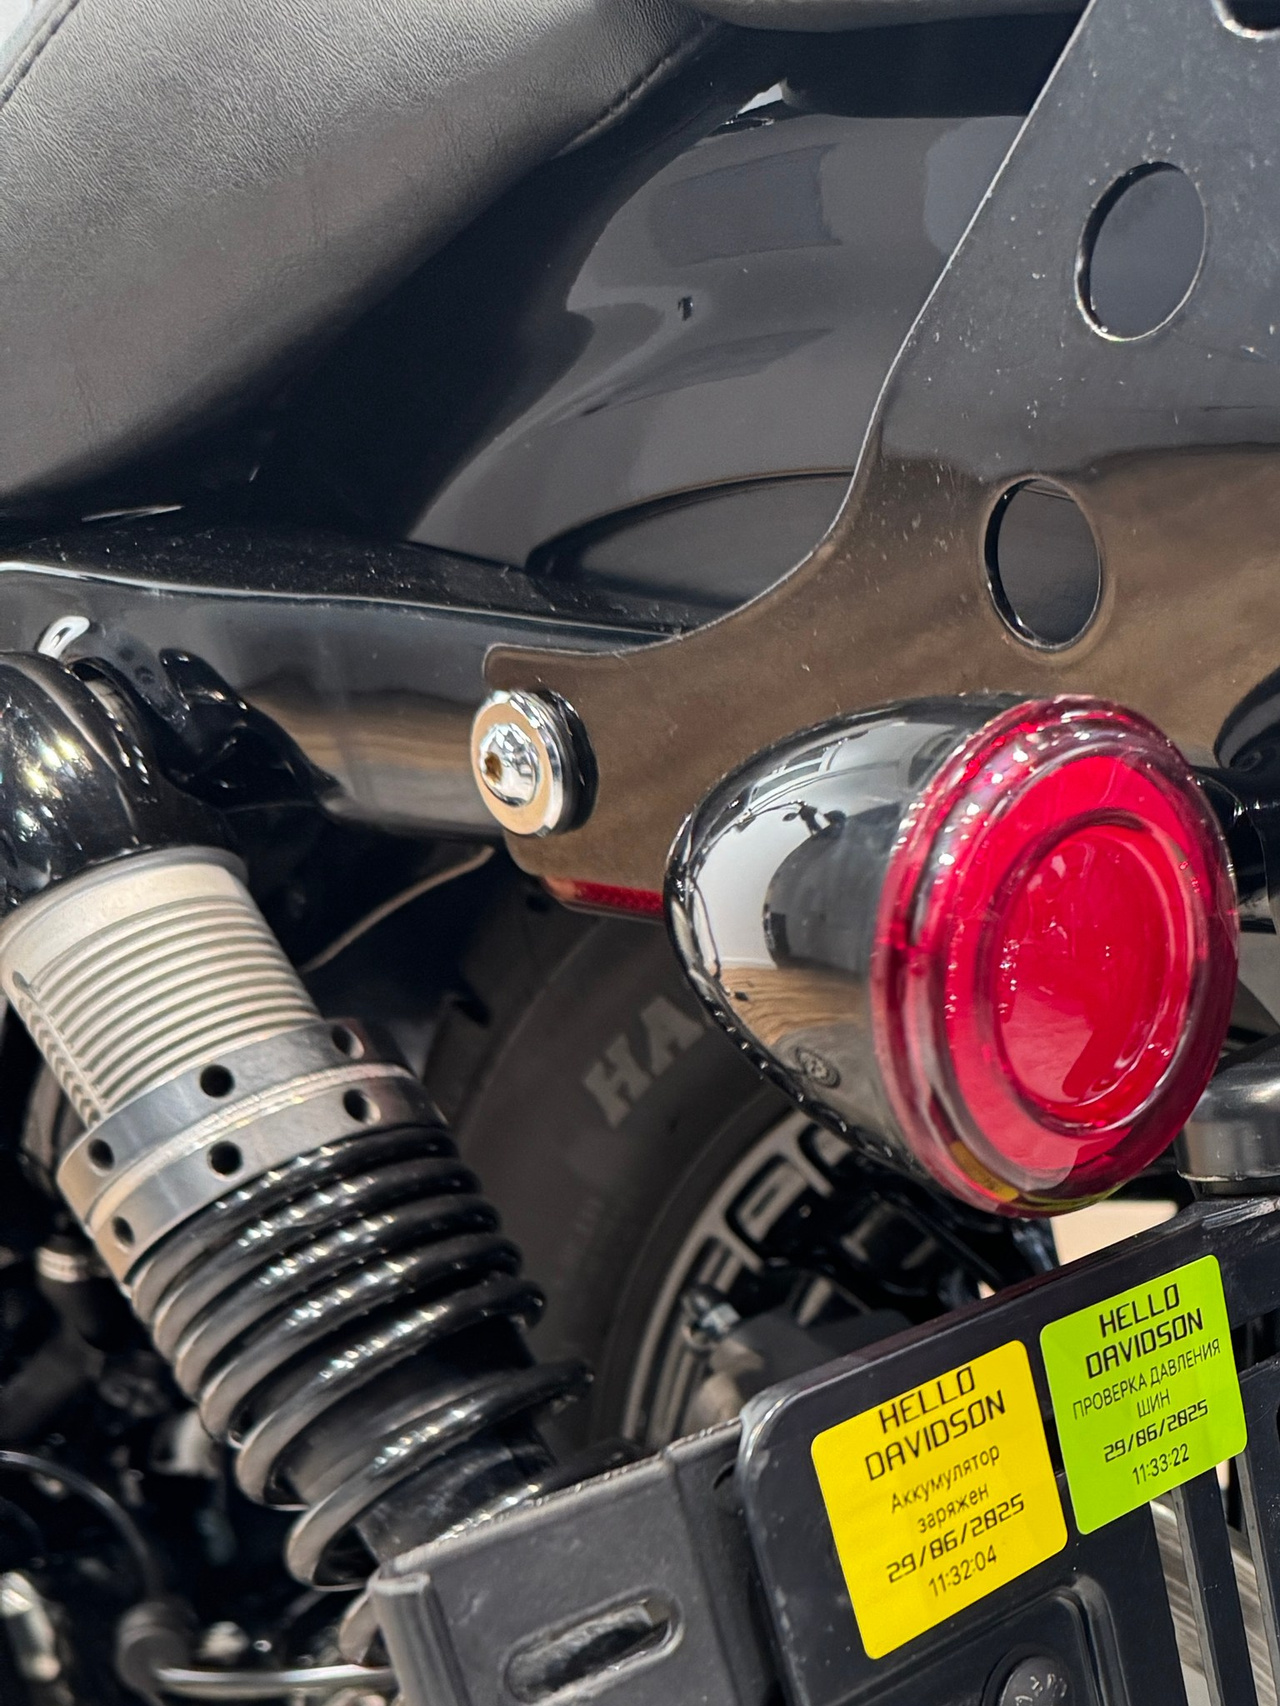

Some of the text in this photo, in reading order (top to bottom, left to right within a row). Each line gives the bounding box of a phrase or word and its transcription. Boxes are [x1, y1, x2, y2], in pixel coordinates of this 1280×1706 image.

[1099, 1283, 1180, 1338] HELLO
[1085, 1307, 1204, 1379] DAVIDSON
[879, 1366, 975, 1434] HELLO
[1073, 1338, 1221, 1420] ПРОВЕРКА ДАВЛЕНИЯ
[1137, 1388, 1171, 1418] ШИН
[865, 1389, 1006, 1481] DAVIDSON
[1132, 1443, 1190, 1485] 11:33:22
[891, 1445, 1001, 1514] Аккумулятор
[917, 1483, 990, 1534] заряжен
[929, 1544, 998, 1598] 11:32:04
